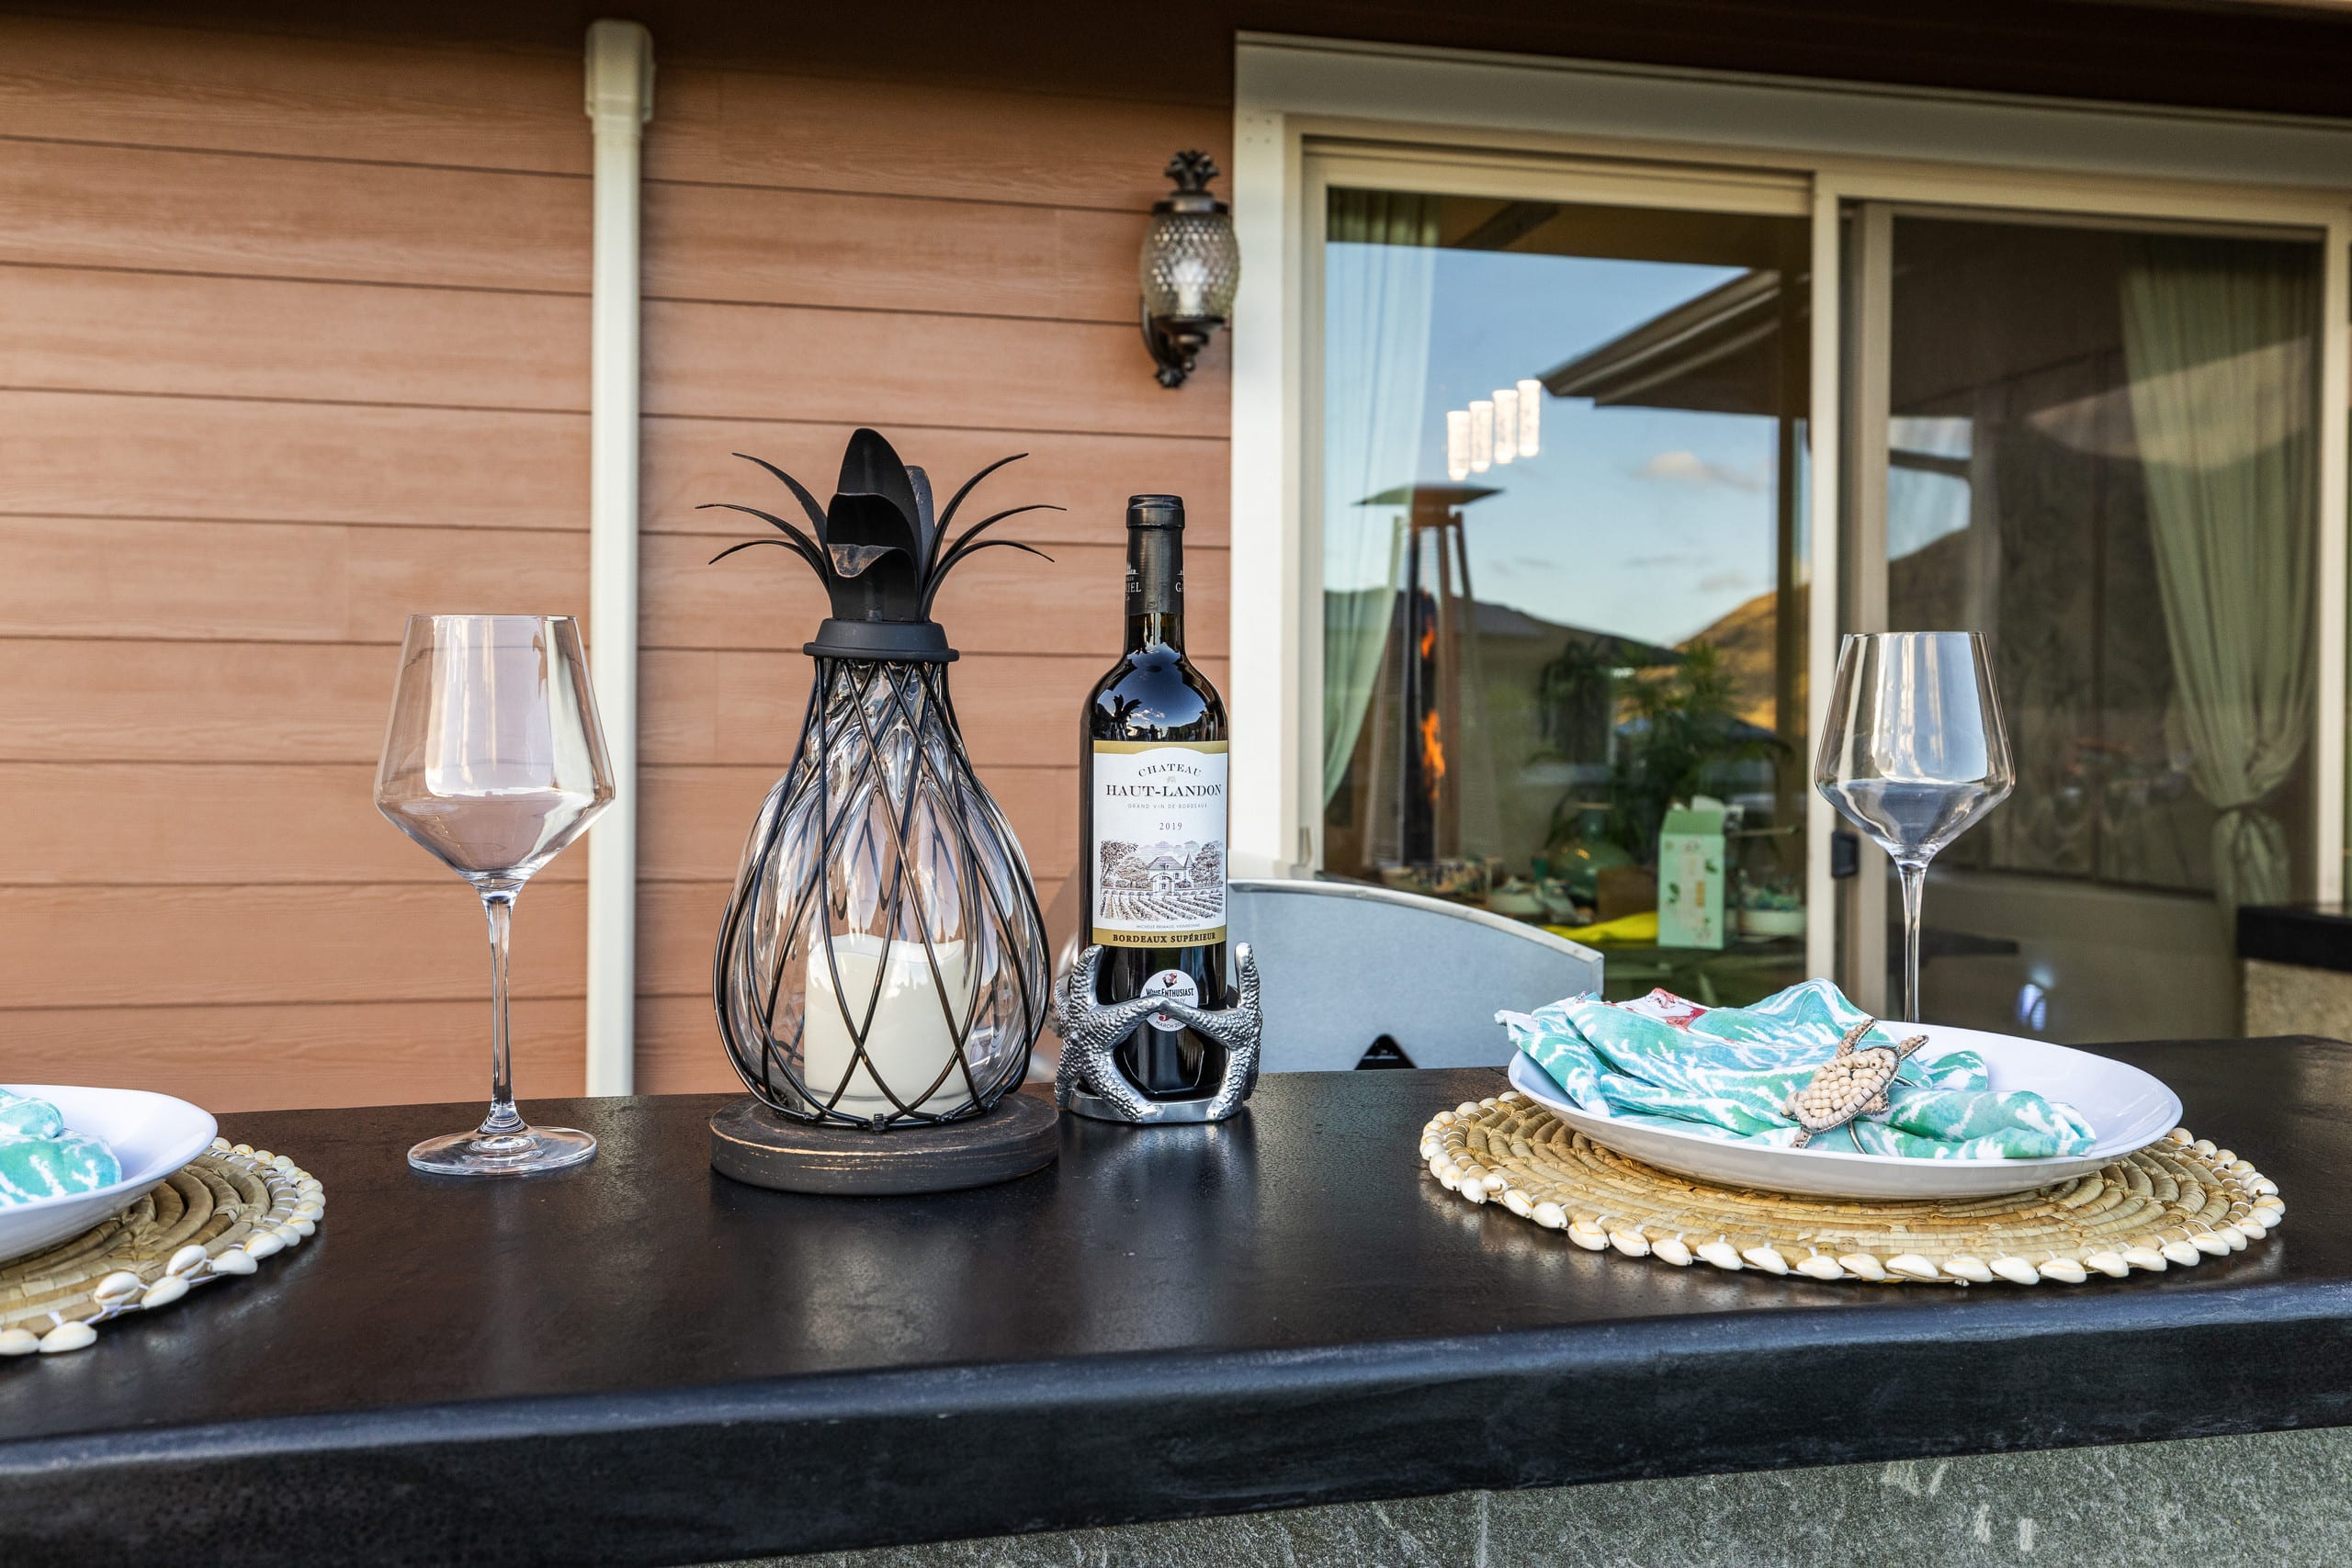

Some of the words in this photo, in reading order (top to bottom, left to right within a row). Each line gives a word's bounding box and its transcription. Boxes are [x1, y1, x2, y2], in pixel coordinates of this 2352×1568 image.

[1138, 763, 1202, 777] CHATEAU
[1106, 784, 1222, 796] HAUT-LANDON
[1159, 822, 1182, 830] 2019
[1113, 933, 1168, 943] BORDEAUX
[1170, 931, 1216, 942] SUPÉRIEUR
[1161, 987, 1194, 998] ENTHUSIAST
[1156, 1021, 1174, 1029] MARCH
